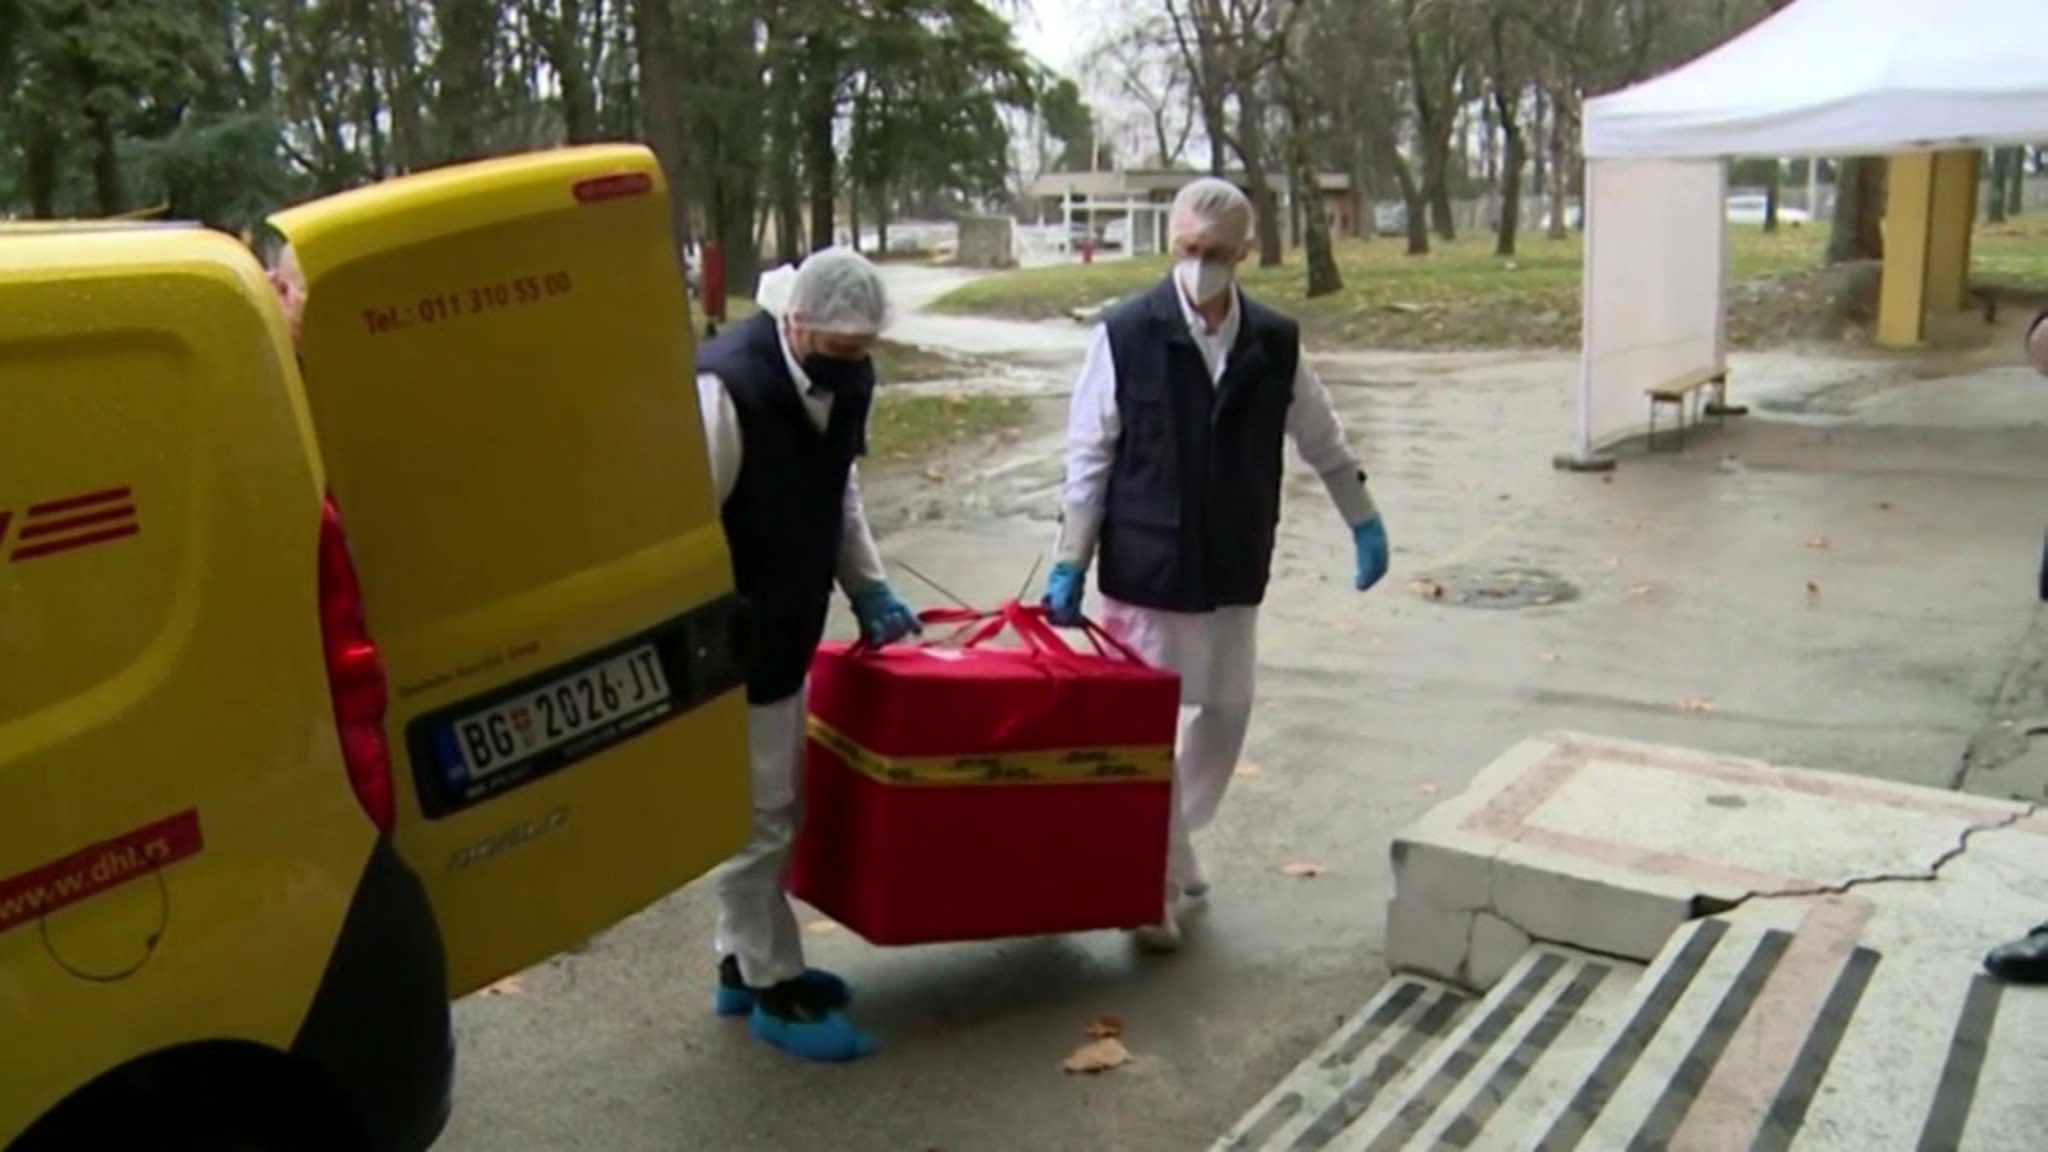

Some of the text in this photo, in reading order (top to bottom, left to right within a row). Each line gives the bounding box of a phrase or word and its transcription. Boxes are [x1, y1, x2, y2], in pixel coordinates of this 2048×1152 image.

[418, 294, 461, 322] 011
[469, 284, 508, 313] 310
[513, 276, 540, 303] 55
[544, 271, 571, 296] 00
[462, 712, 515, 769] BG
